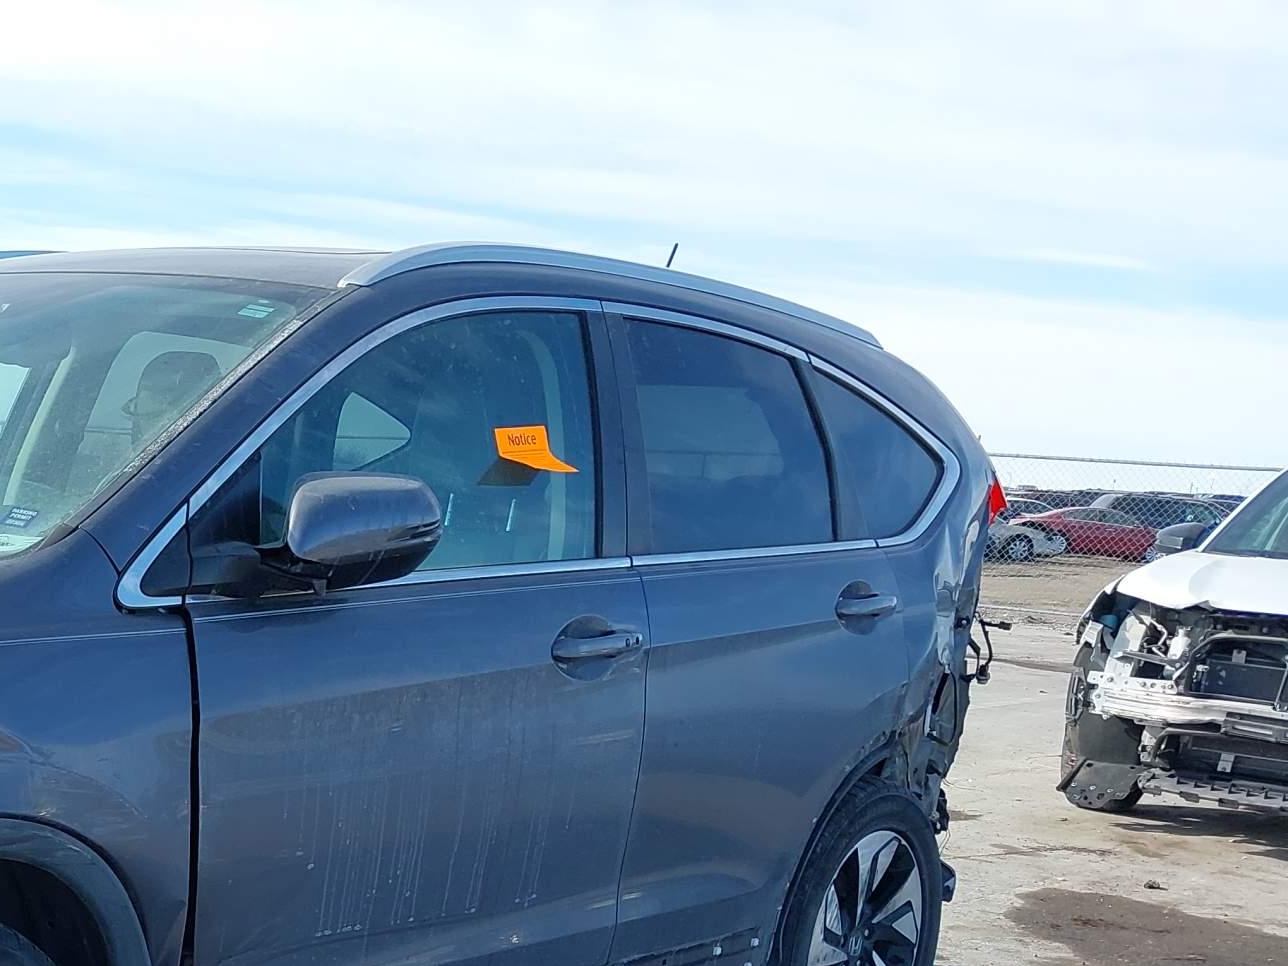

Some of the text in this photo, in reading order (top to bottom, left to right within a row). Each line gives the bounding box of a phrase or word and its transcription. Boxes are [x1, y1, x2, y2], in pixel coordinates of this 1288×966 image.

[507, 433, 537, 446] Notice
[11, 508, 38, 516] PARKING
[9, 513, 33, 521] PERMIT
